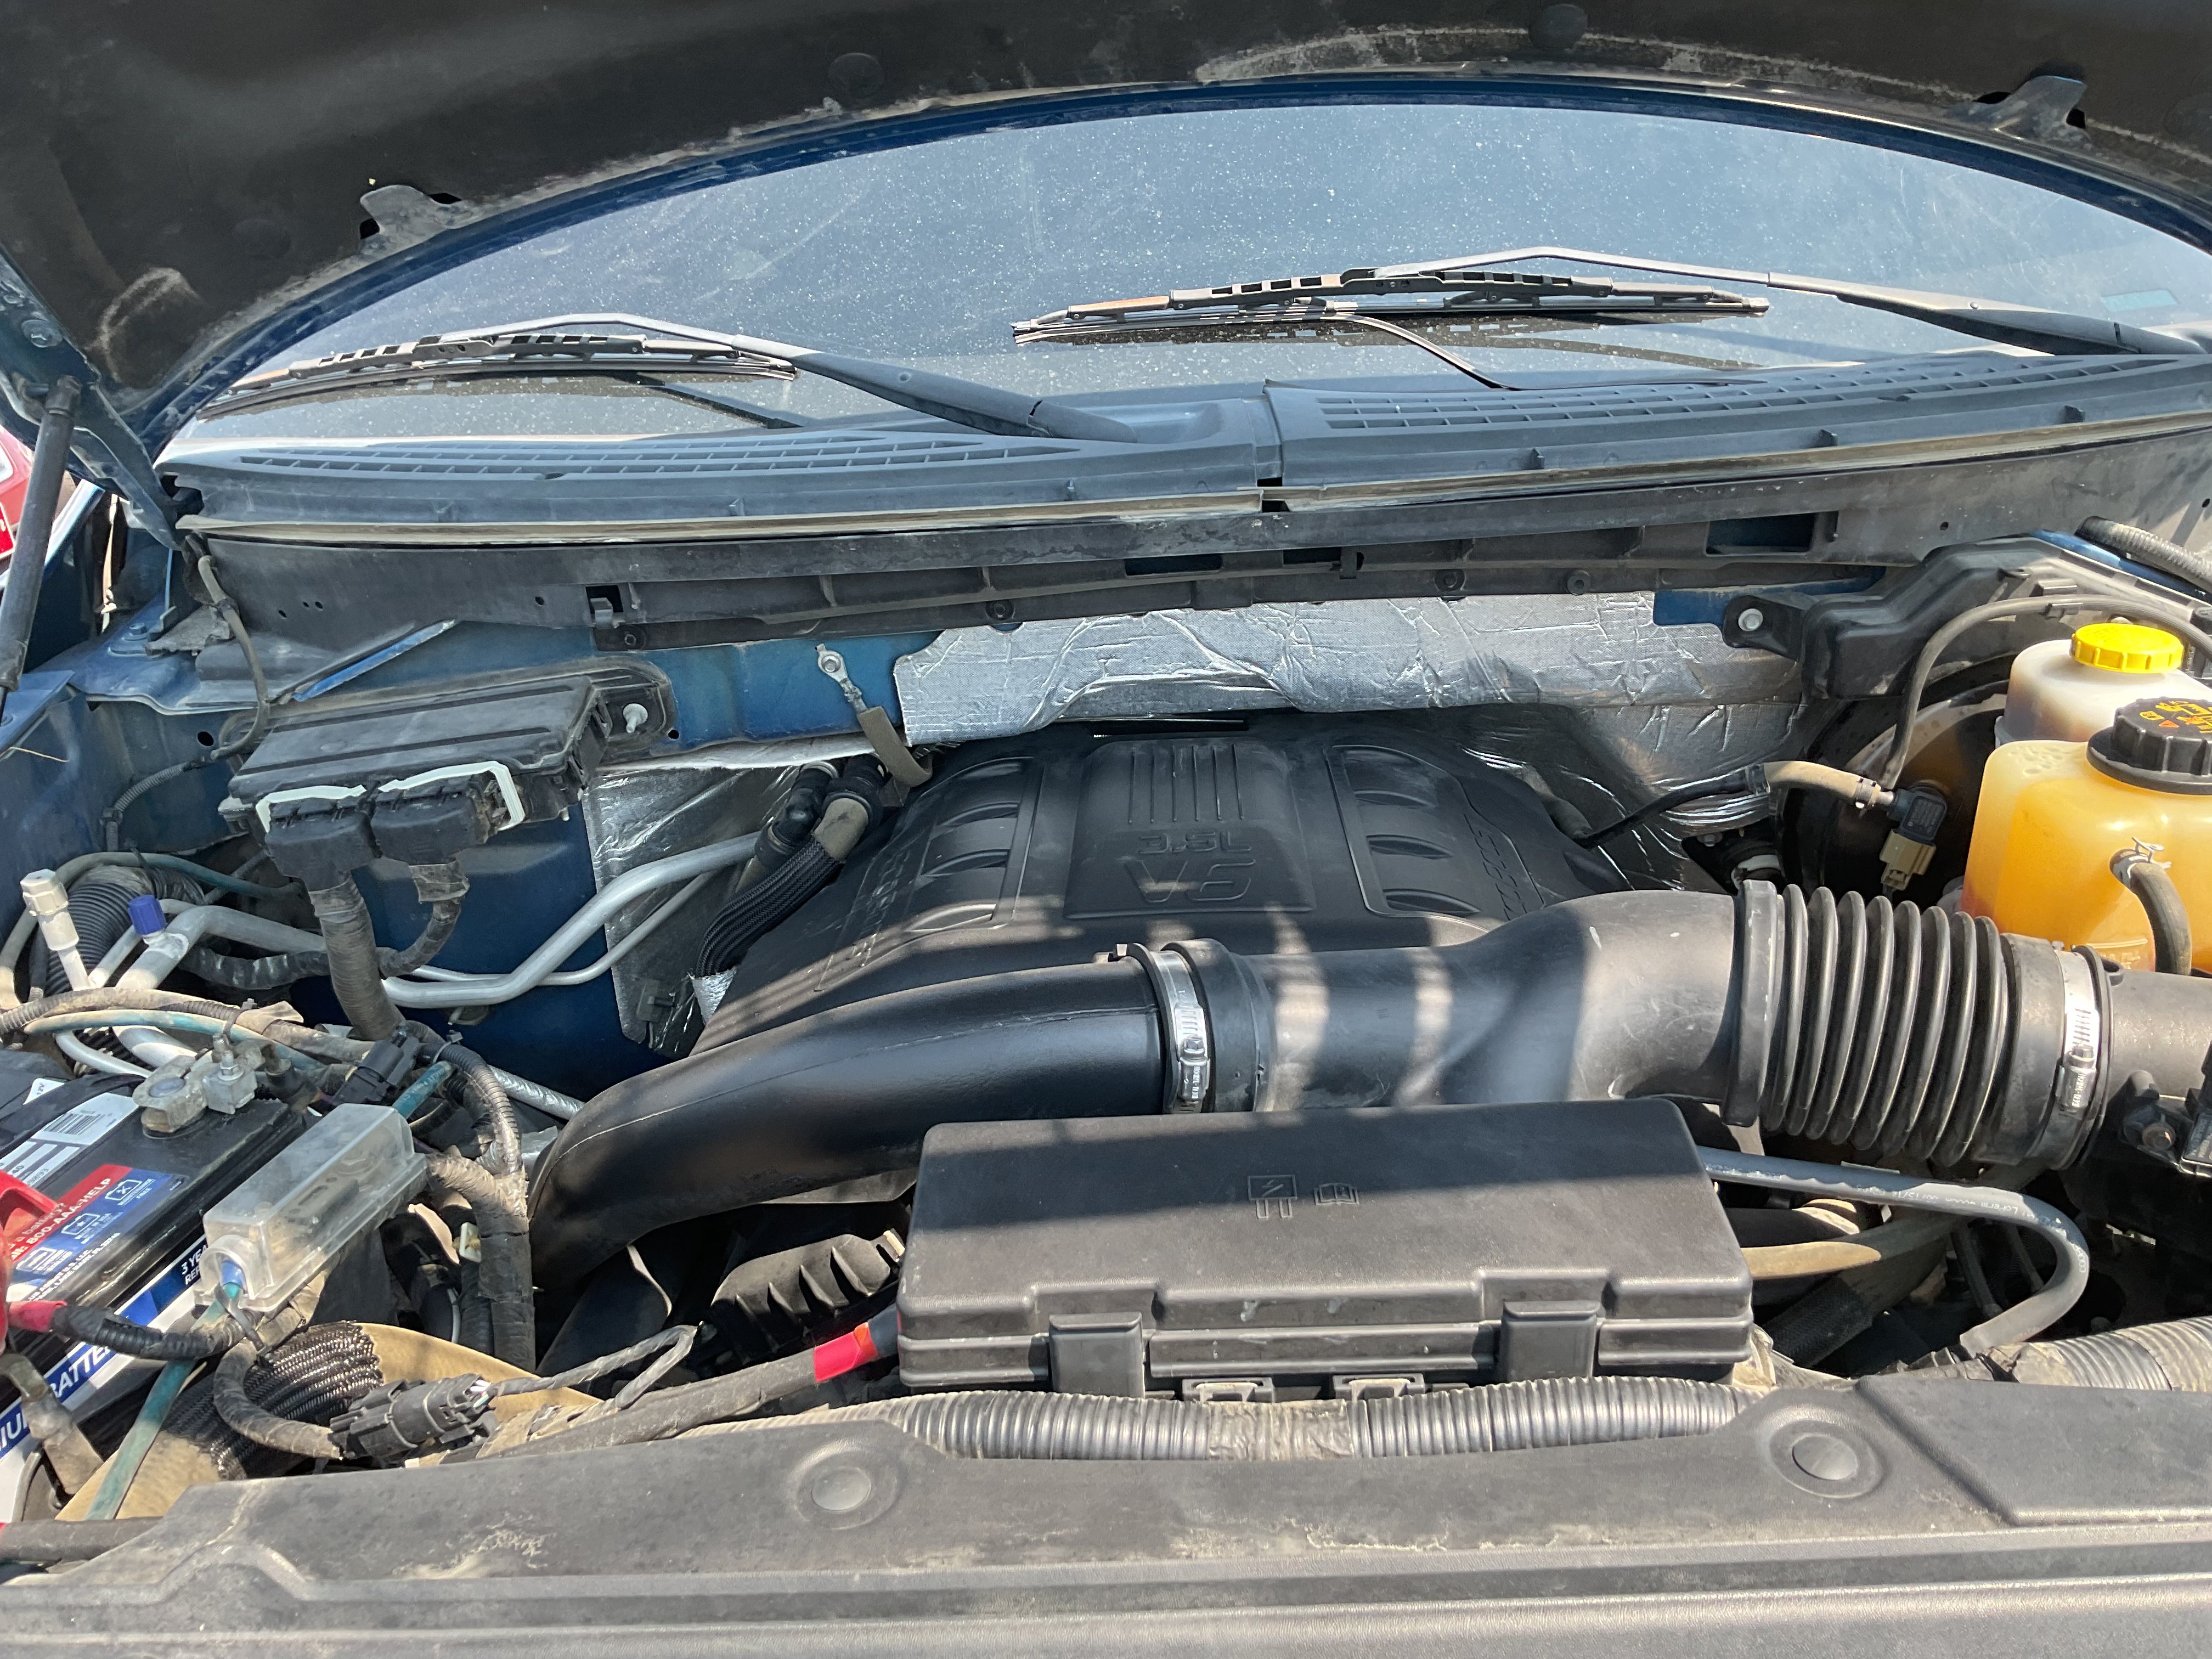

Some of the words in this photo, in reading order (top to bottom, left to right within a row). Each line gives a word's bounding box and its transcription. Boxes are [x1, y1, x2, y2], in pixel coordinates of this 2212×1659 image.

[1122, 857, 1257, 904] V6
[26, 1178, 111, 1244] 800-AAA-HELP
[181, 1261, 188, 1275] 3
[189, 1245, 207, 1267] YEA
